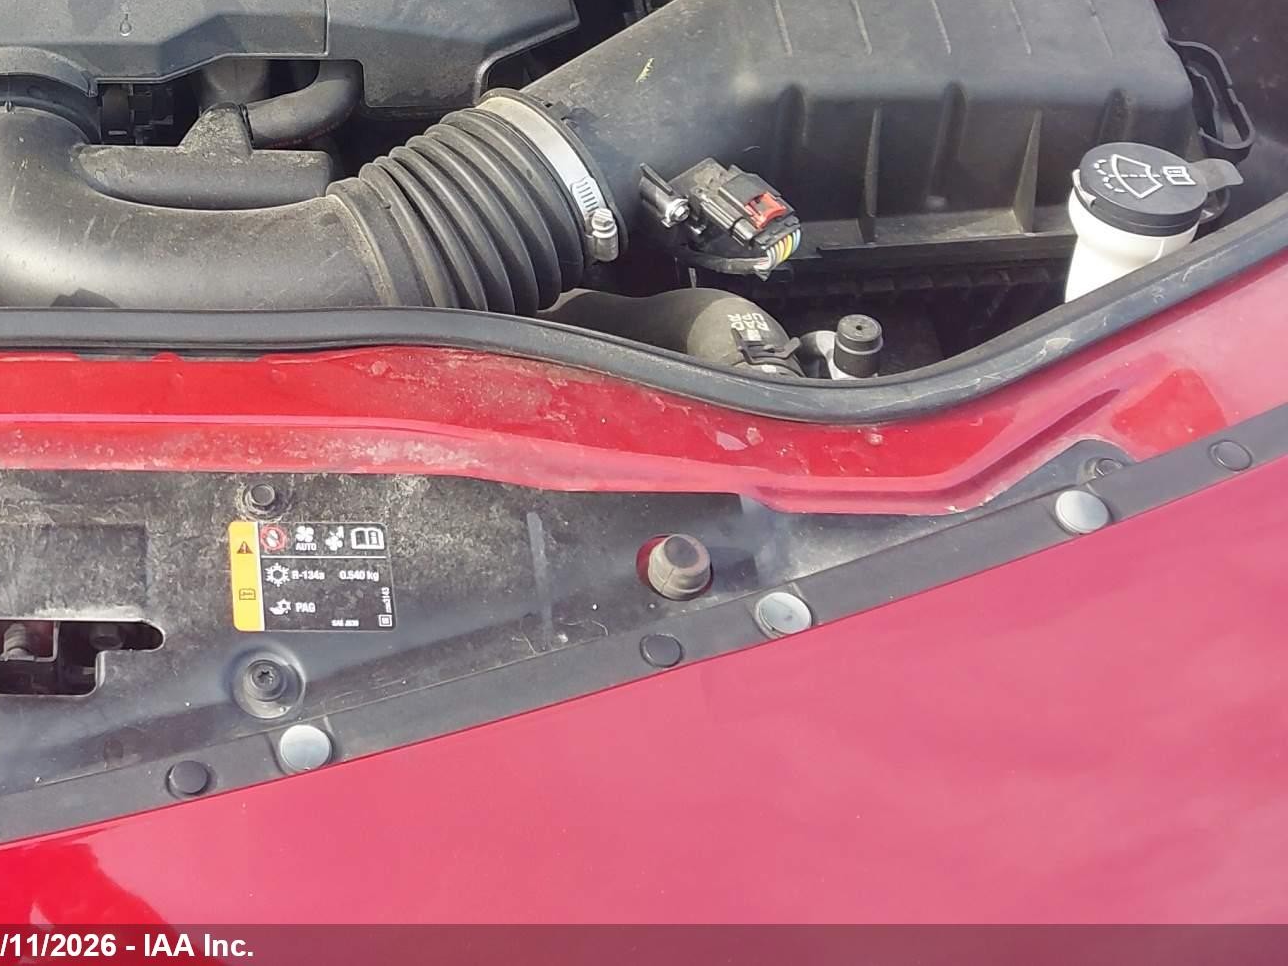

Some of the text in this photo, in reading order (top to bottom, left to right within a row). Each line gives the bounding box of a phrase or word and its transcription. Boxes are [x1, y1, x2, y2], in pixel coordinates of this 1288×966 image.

[727, 312, 765, 322] UPR
[731, 320, 770, 331] RAD
[295, 542, 317, 551] AUTO
[291, 570, 326, 580] R-134a
[366, 570, 380, 582] kg
[295, 601, 316, 613] PAG
